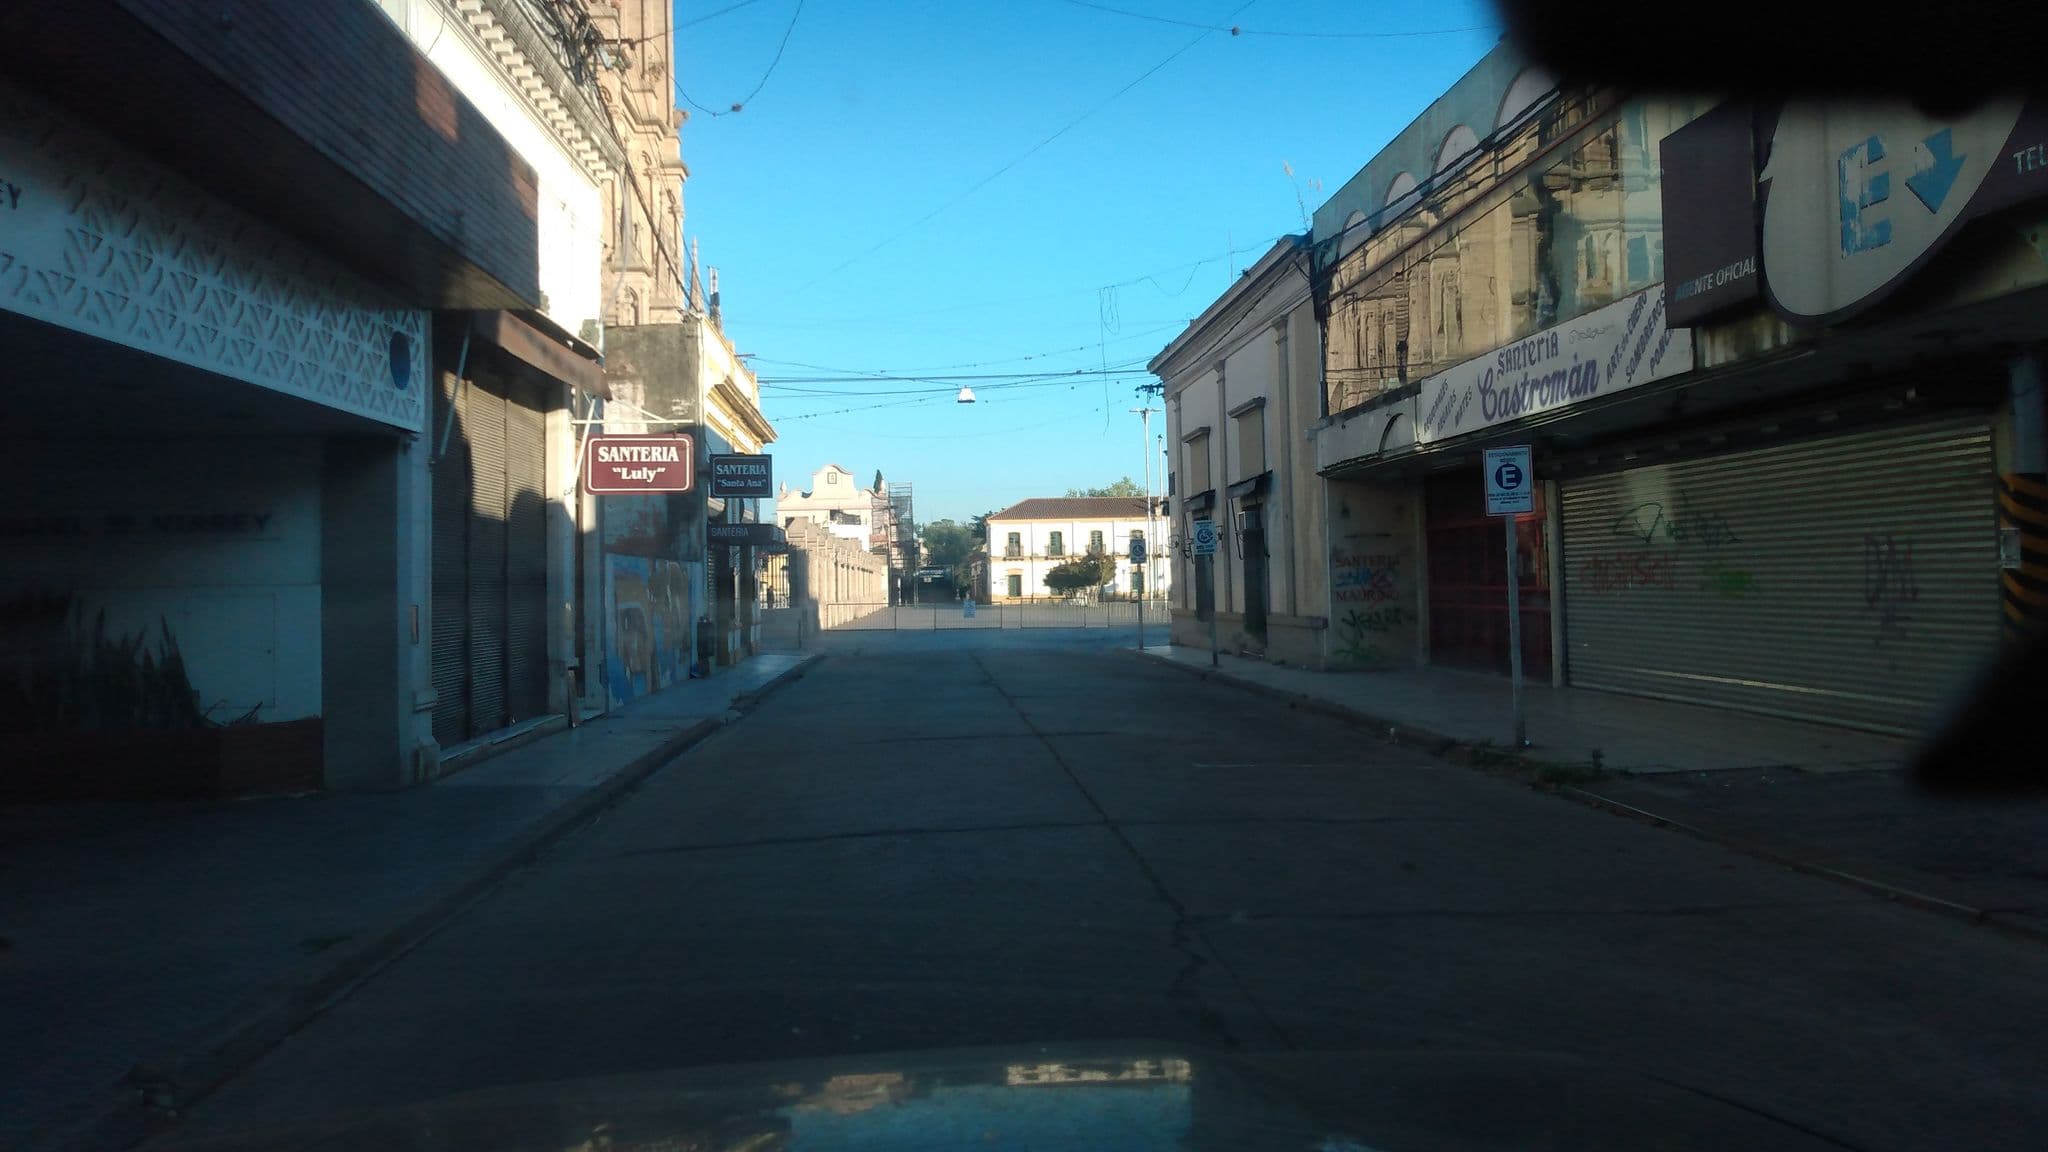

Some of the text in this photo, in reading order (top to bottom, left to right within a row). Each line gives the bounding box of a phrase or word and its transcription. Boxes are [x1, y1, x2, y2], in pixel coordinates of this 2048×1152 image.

[1716, 256, 1757, 286] OFICIAL
[1478, 352, 1600, 422] Castromán
[598, 446, 680, 462] SANTERIA
[612, 467, 666, 483] "Luly"
[715, 464, 767, 475] SANTERIA
[1502, 466, 1517, 487] E
[710, 527, 750, 537] SANTERIA
